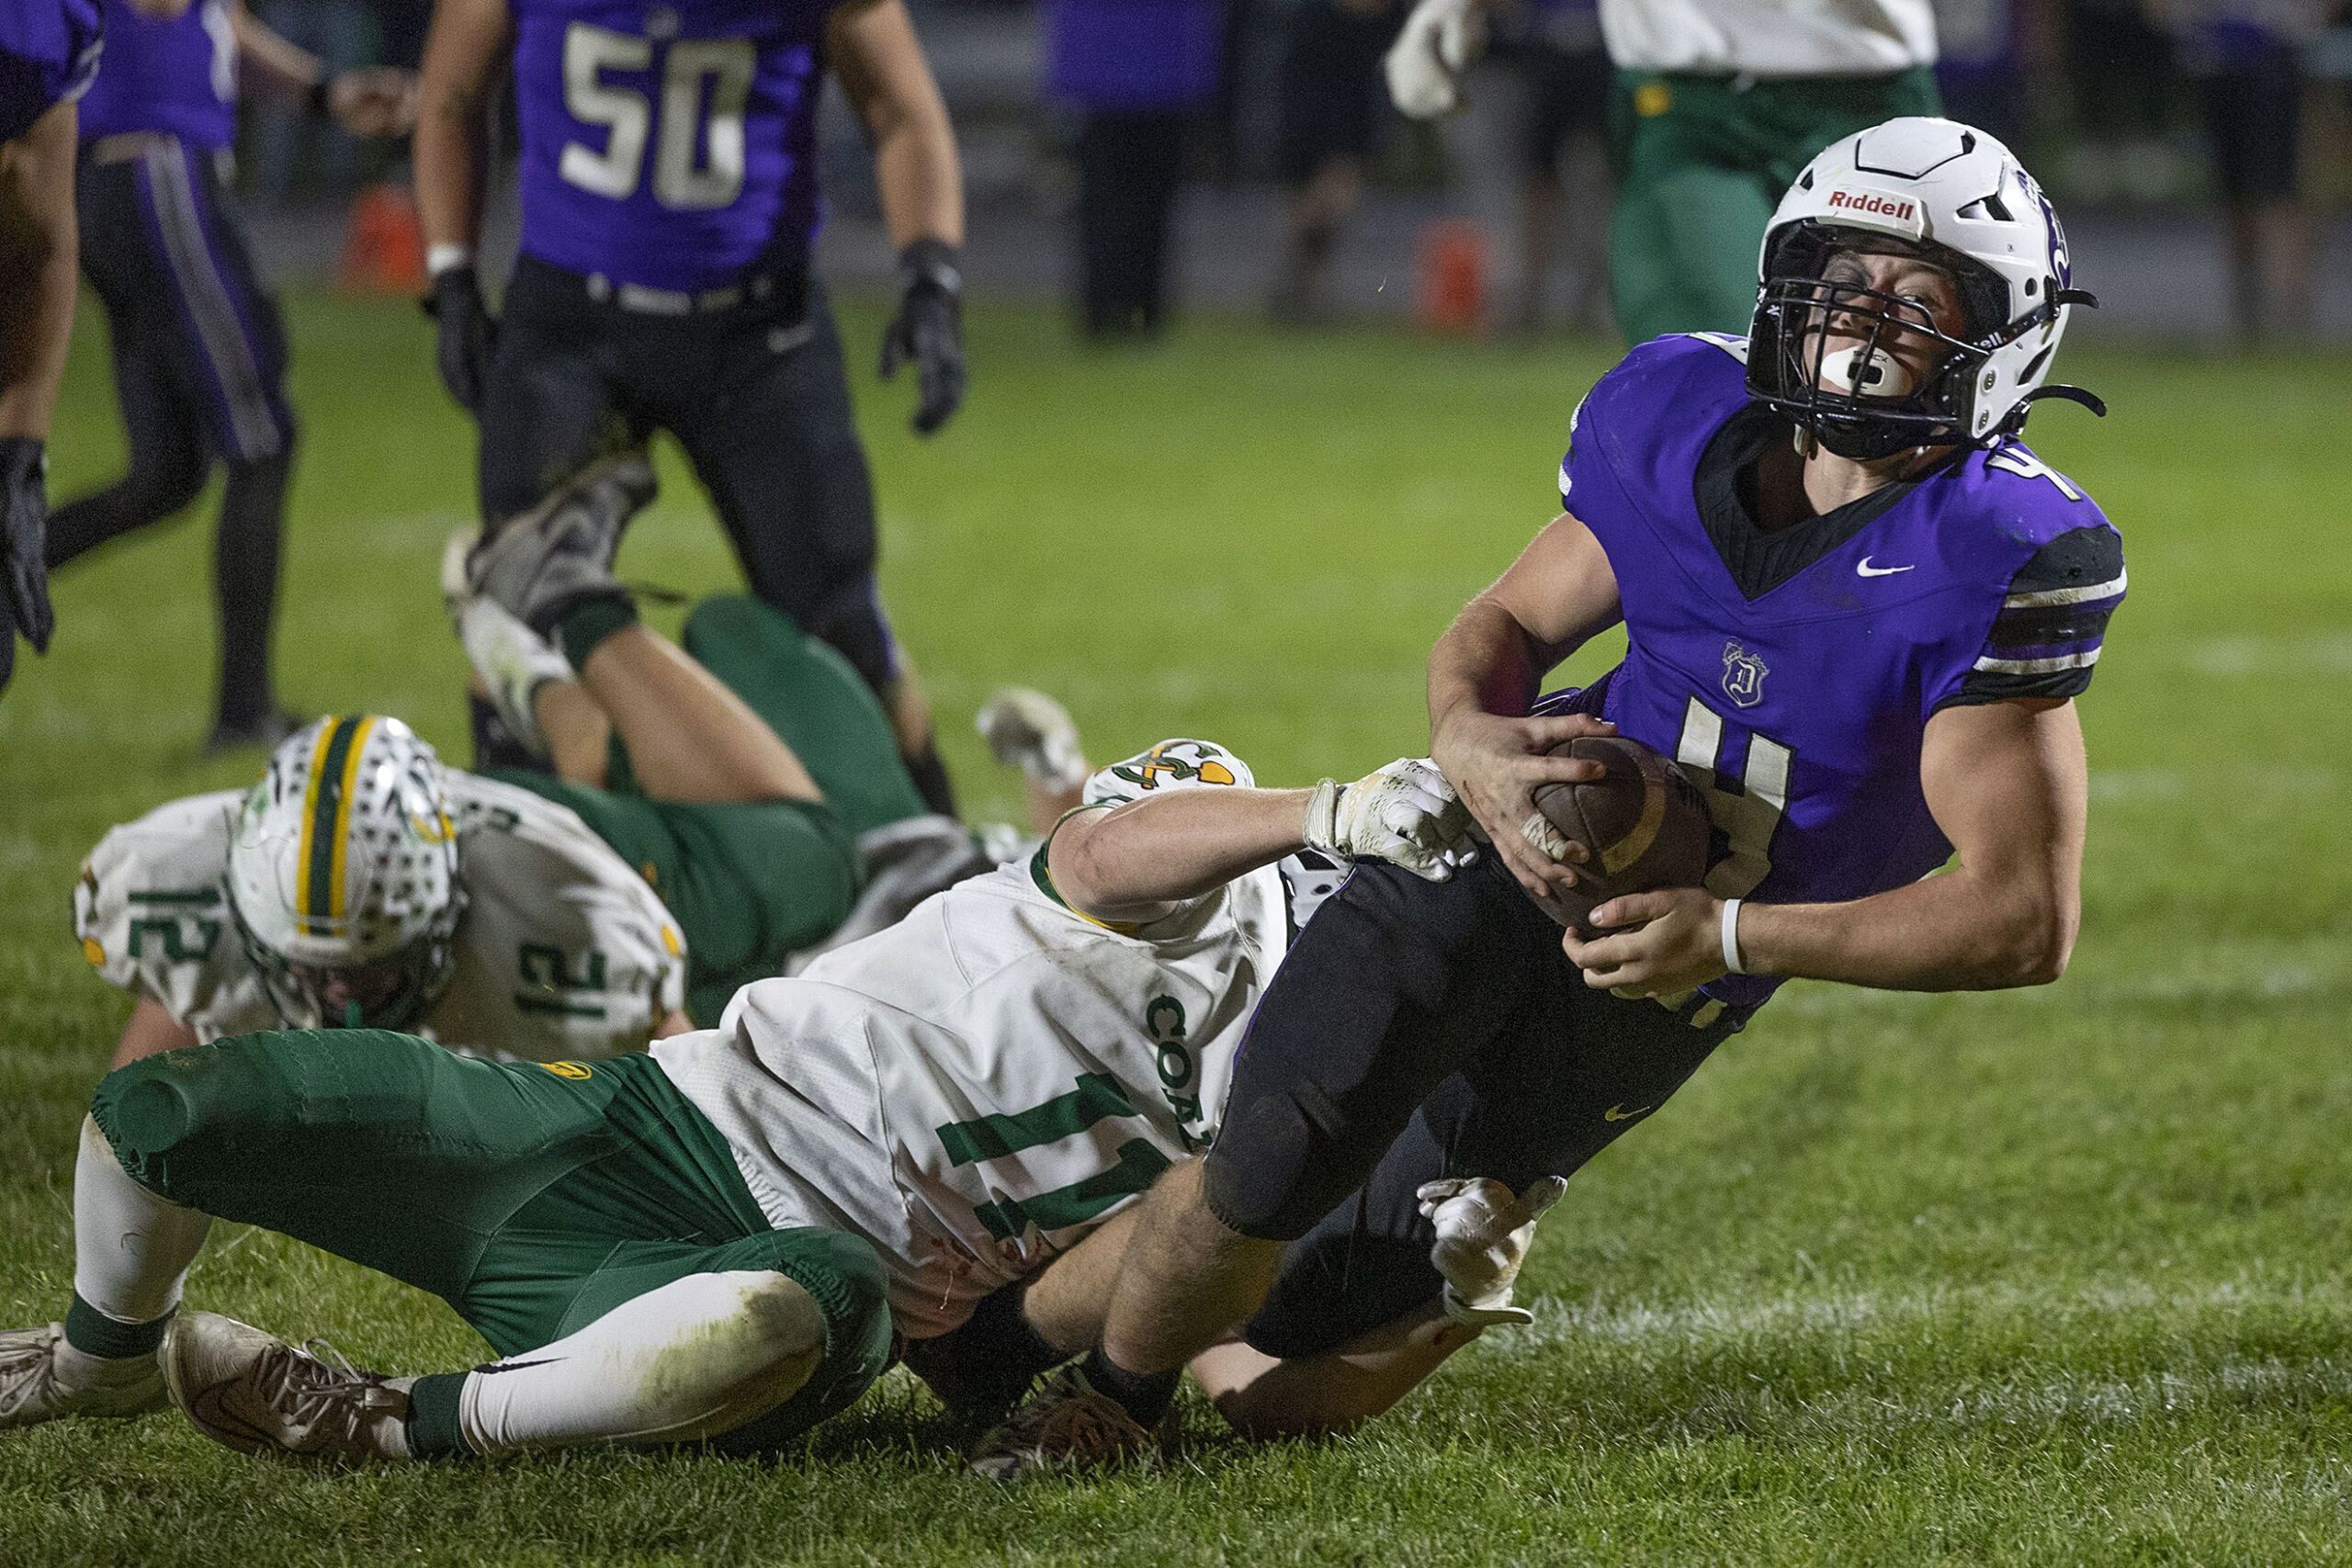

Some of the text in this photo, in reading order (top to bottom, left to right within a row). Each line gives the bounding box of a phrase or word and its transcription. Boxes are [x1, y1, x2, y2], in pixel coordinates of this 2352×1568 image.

[559, 21, 755, 210] 50
[1828, 190, 1914, 220] Riddell
[128, 887, 220, 961] 12
[514, 943, 605, 1019] 12
[935, 1072, 1172, 1241] 11
